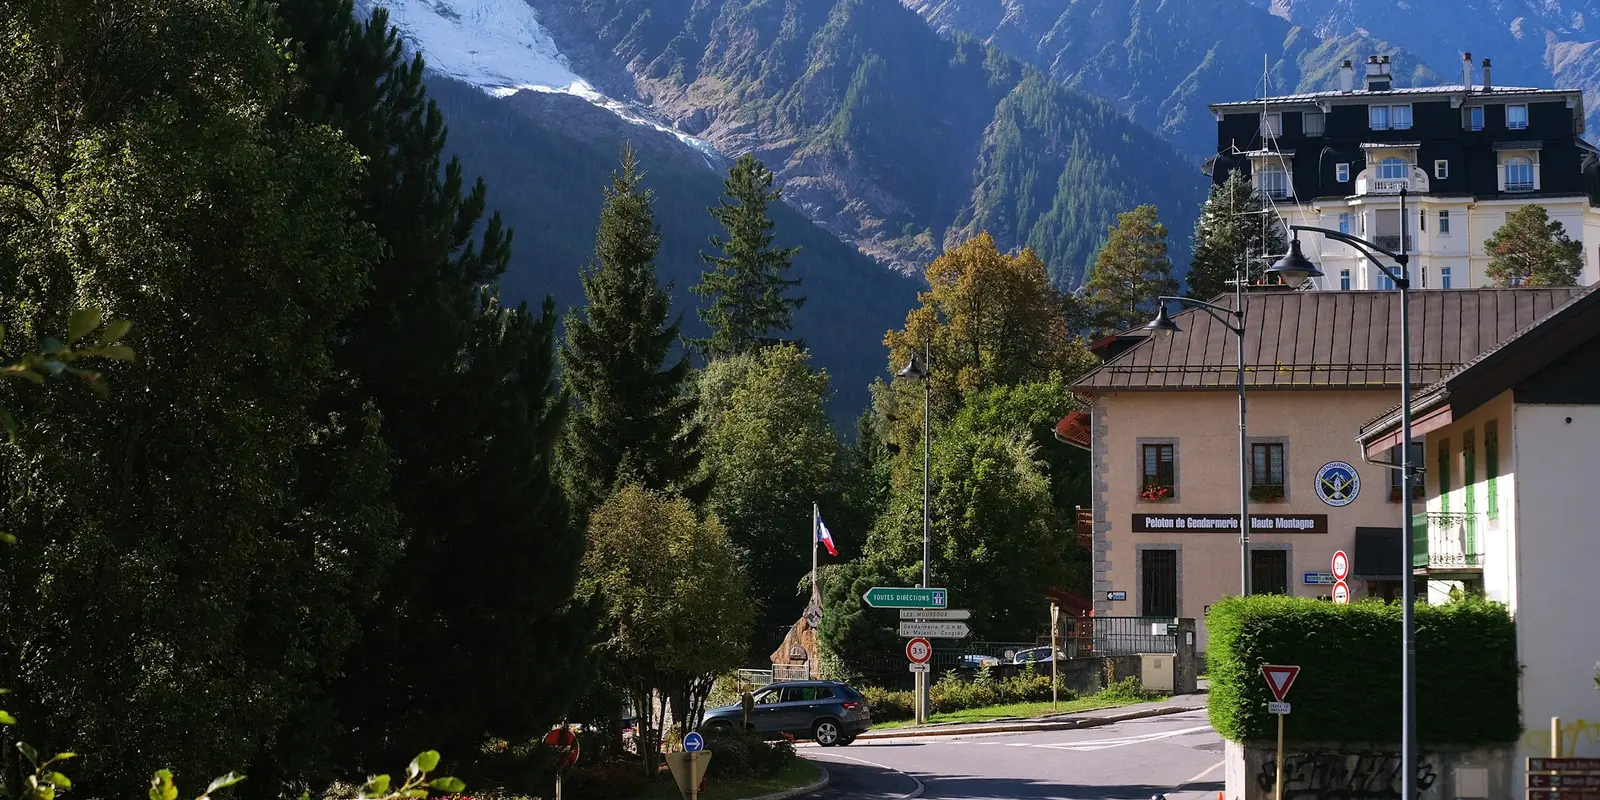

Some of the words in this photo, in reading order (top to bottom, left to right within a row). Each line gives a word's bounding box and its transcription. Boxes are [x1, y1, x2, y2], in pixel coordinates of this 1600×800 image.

[1145, 516, 1174, 528] Peloton
[1175, 517, 1185, 528] de
[1186, 516, 1238, 529] Gendarmerie
[1251, 517, 1274, 529] Haute
[1275, 517, 1315, 531] Montagne
[896, 594, 930, 602] DIRECTIONS
